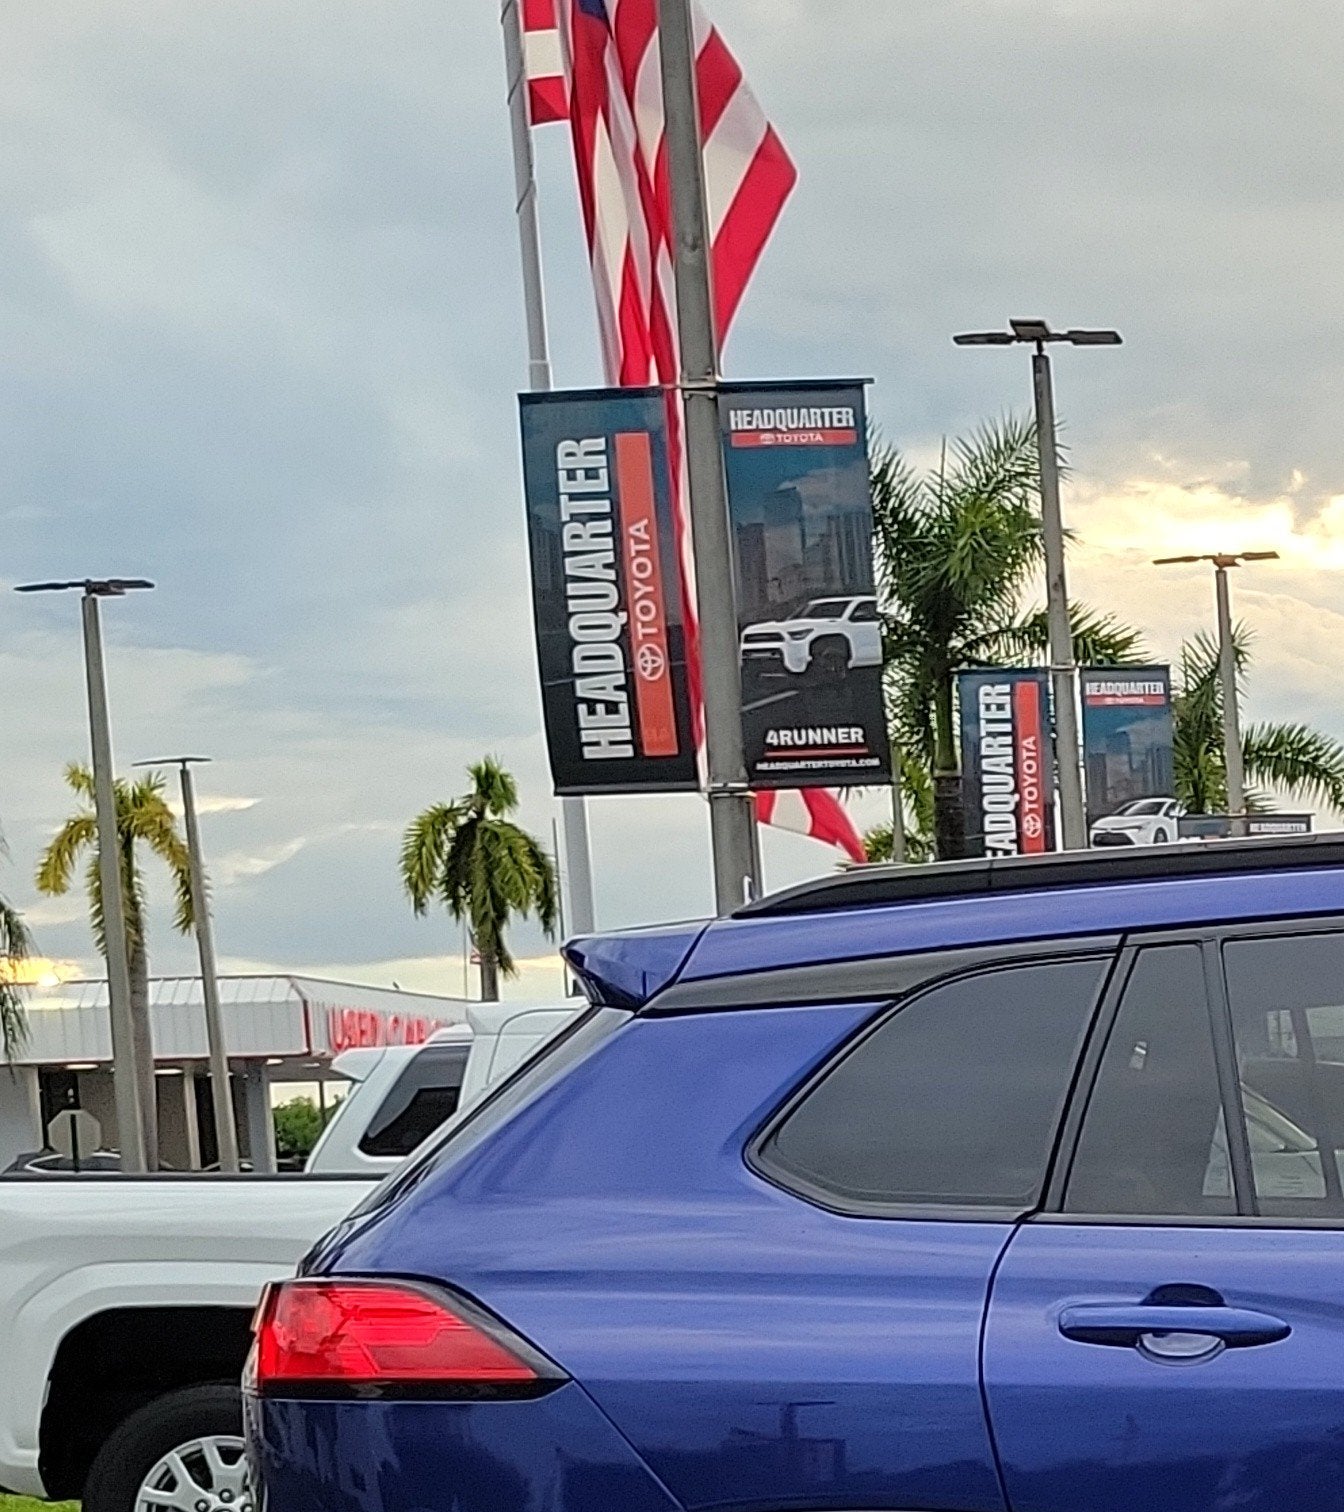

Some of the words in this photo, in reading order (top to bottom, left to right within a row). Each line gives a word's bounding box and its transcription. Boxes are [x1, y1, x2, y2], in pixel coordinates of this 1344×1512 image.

[729, 407, 855, 431] HEADQUARTER
[776, 432, 824, 443] TOYOTA
[556, 436, 634, 760] HEADQUARTER
[630, 518, 659, 640] TOYOTA
[766, 727, 864, 746] 4RUNNER
[979, 683, 1020, 857] ADQUARTER
[1022, 735, 1040, 812] TOYOTA
